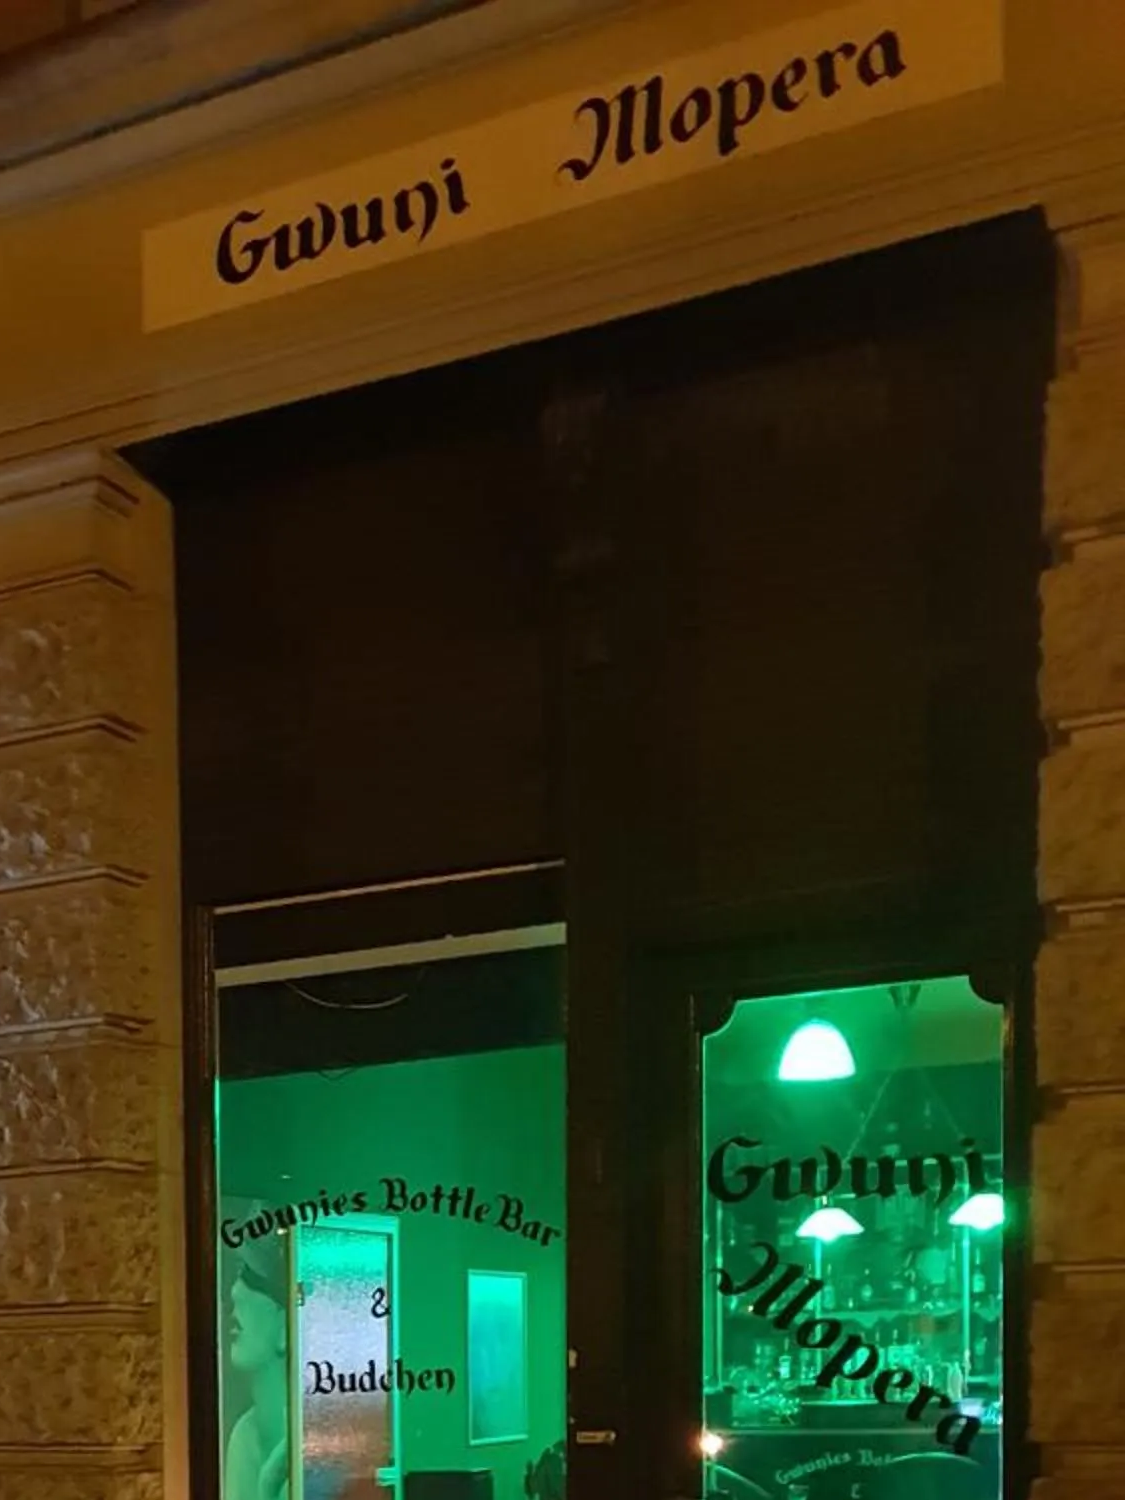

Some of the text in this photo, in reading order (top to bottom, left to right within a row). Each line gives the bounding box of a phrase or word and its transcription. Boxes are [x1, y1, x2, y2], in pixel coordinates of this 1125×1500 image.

[215, 29, 907, 285] Gwuni Mopera
[379, 1177, 490, 1224] Bottle
[496, 1194, 561, 1247] Bar
[371, 1287, 391, 1319] &
[707, 1136, 989, 1456] Gwuni Mopera
